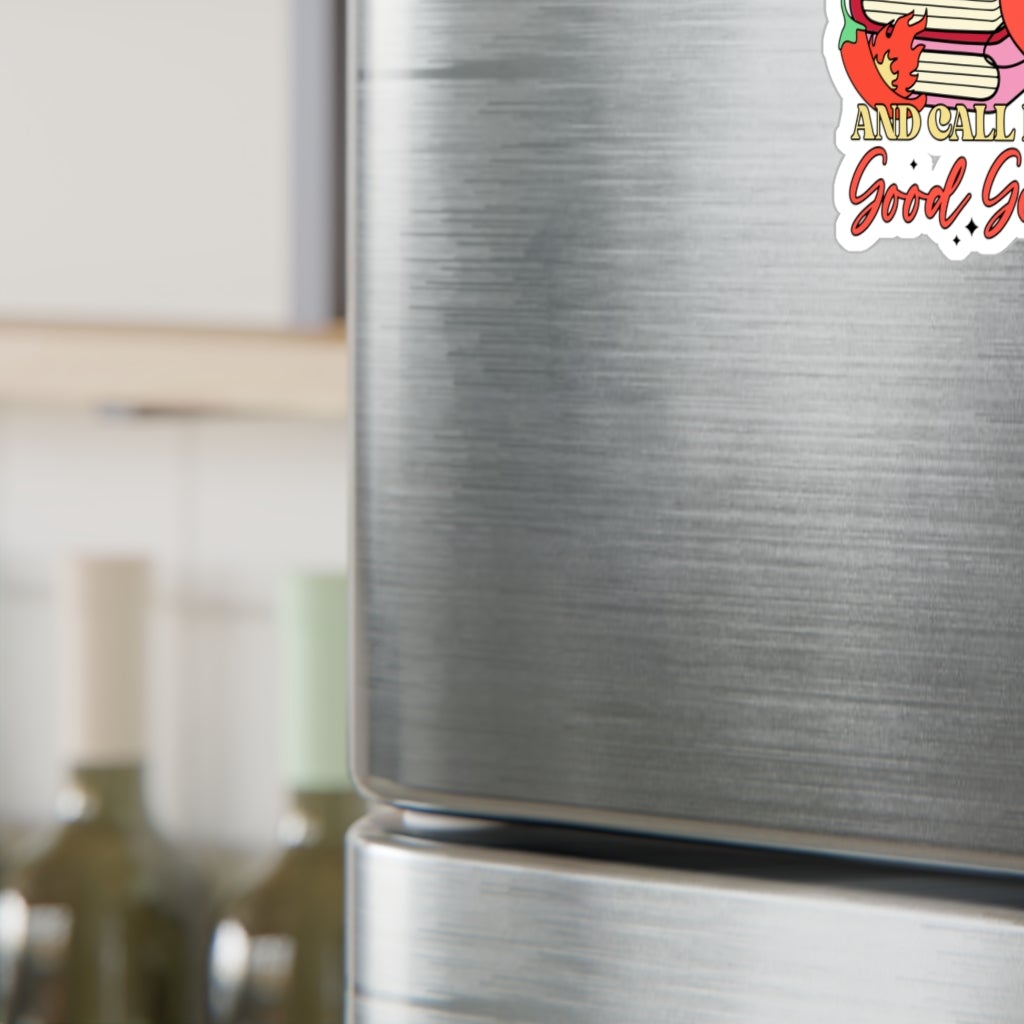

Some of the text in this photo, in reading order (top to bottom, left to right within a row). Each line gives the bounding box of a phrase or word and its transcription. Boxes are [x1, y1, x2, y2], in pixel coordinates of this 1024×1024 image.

[850, 103, 921, 141] AND
[927, 103, 1016, 142] CALL
[849, 146, 972, 236] Good
